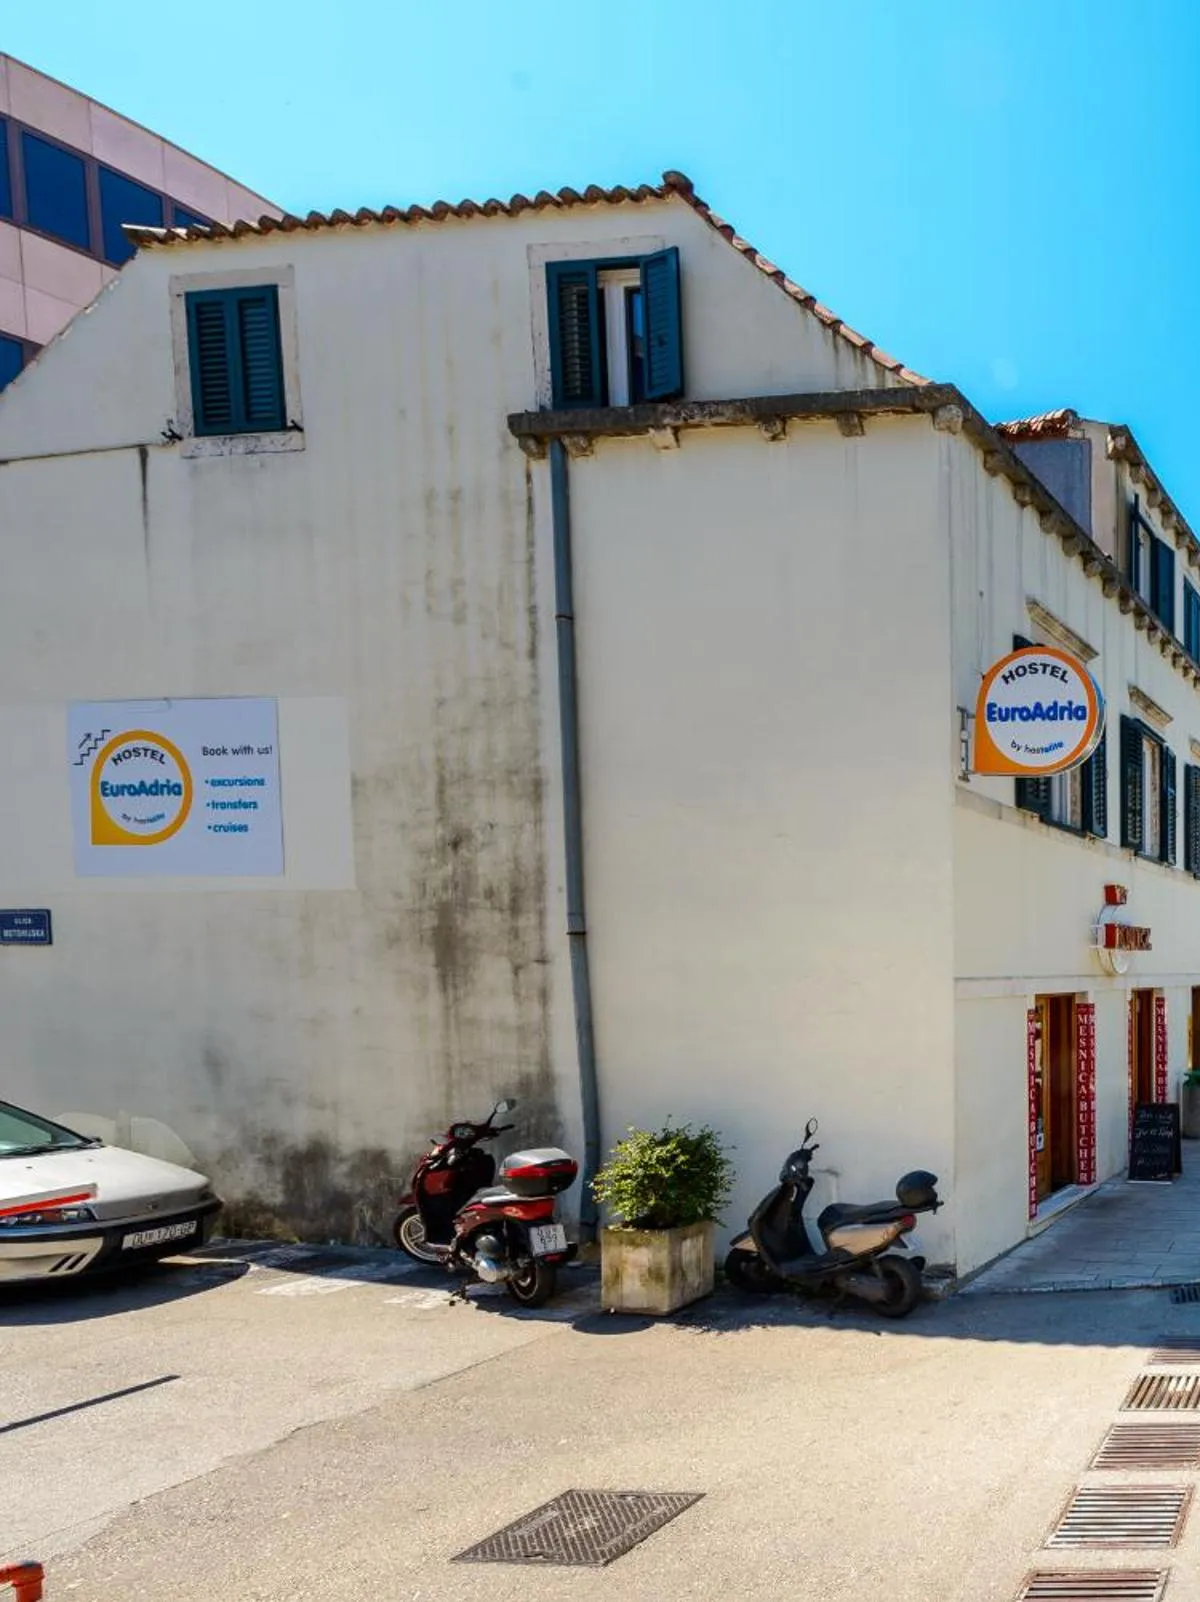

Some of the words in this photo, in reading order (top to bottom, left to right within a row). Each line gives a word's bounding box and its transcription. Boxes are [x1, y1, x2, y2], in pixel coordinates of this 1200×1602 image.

[1001, 662, 1069, 685] HOSTEL
[986, 701, 1087, 722] EuroAdria
[202, 745, 228, 756] Book
[231, 744, 254, 756] with
[256, 744, 273, 755] us!
[1010, 739, 1022, 752] by
[111, 747, 165, 766] HOSTEL
[100, 778, 182, 798] EuroAdria
[211, 798, 258, 810] transfers
[212, 821, 249, 833] cruises
